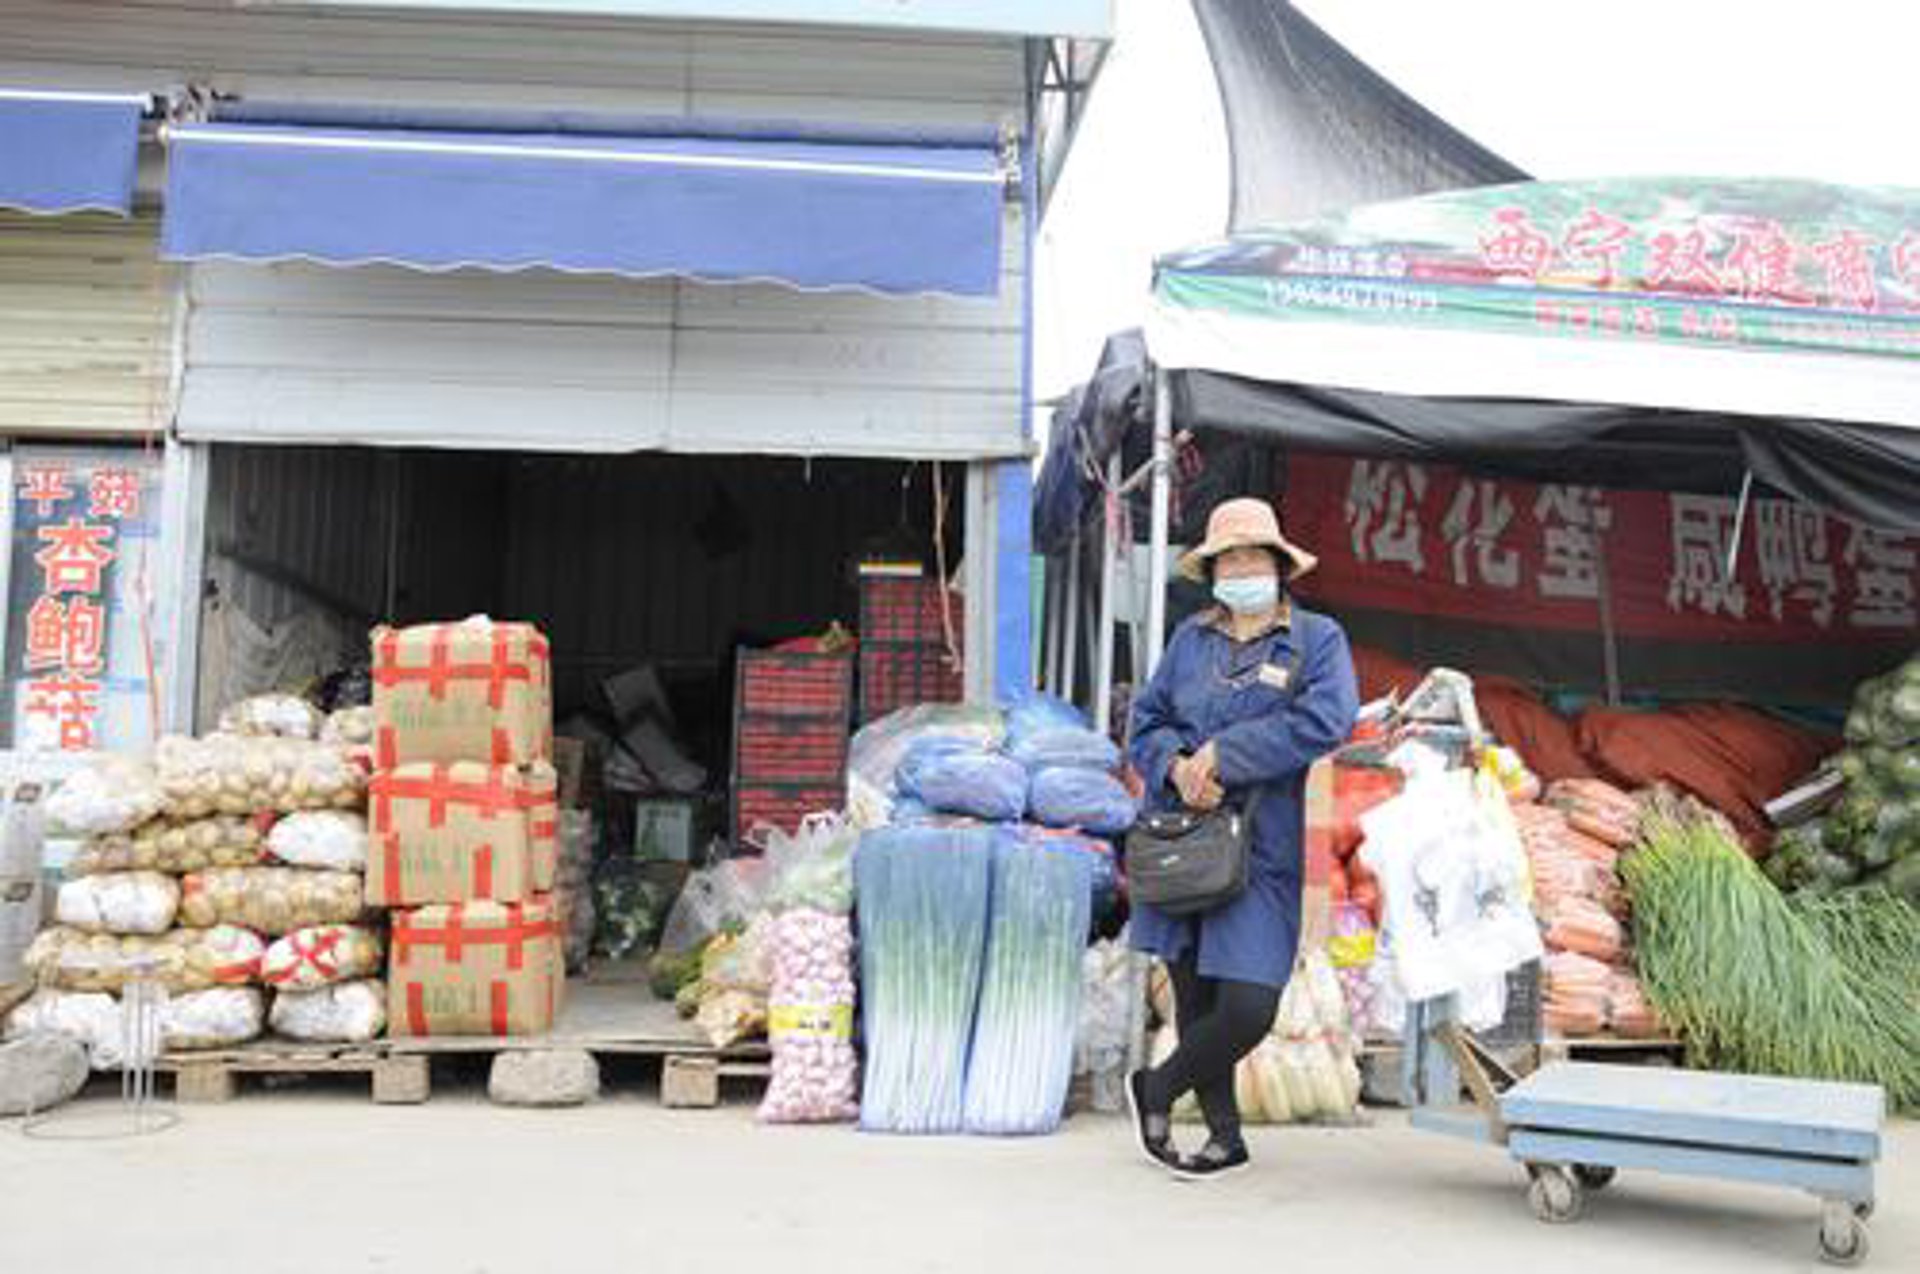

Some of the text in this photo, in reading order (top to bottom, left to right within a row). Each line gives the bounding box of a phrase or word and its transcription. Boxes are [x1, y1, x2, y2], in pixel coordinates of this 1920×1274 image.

[18, 466, 140, 516] 平菇
[1346, 459, 1612, 599] 松化蛋
[1668, 492, 1918, 628] 咸鸭蛋
[23, 516, 116, 750] 杏鲍菇
